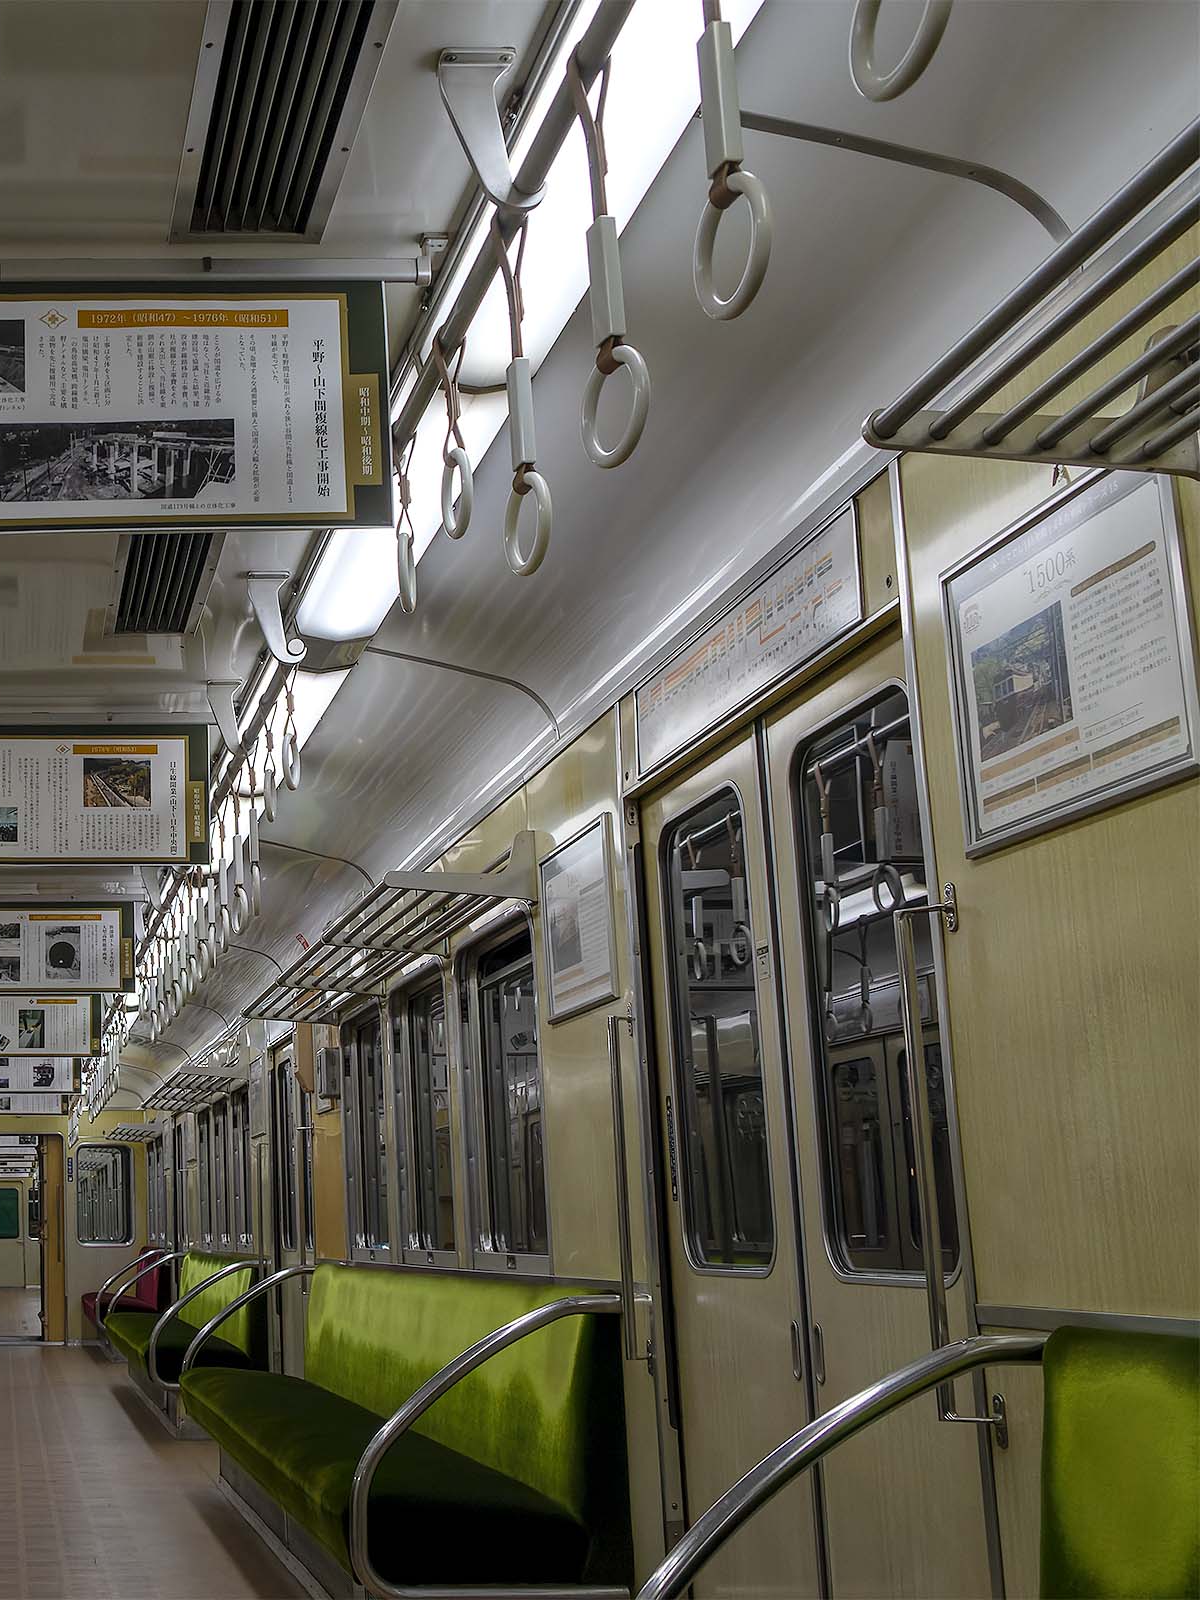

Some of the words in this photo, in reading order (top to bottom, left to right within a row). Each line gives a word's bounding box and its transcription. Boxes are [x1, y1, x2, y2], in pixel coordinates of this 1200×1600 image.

[359, 386, 373, 475] 昭和中期〜昭和後期
[1024, 547, 1080, 594] 1500系
